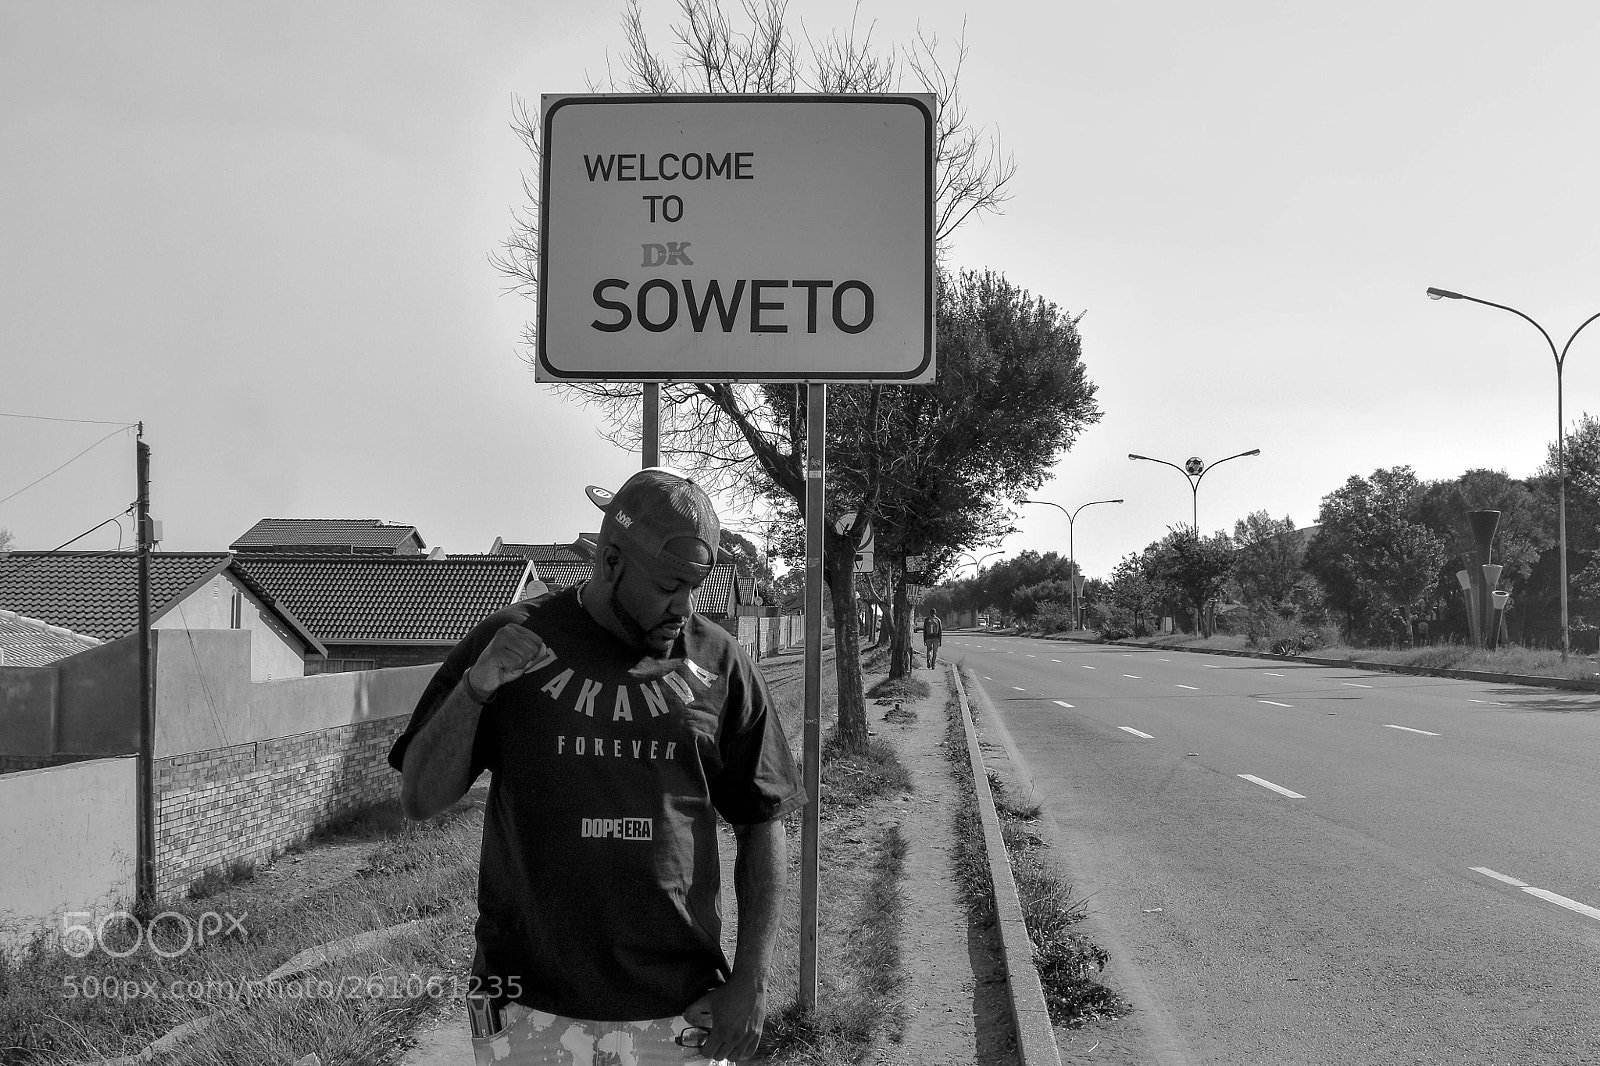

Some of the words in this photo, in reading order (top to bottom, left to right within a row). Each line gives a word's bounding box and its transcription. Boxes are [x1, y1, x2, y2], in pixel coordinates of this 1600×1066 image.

[583, 152, 754, 182] WELCOME
[642, 194, 684, 223] TO
[641, 241, 694, 267] DK
[590, 278, 875, 335] SOWETO
[557, 735, 677, 760] FOREVER
